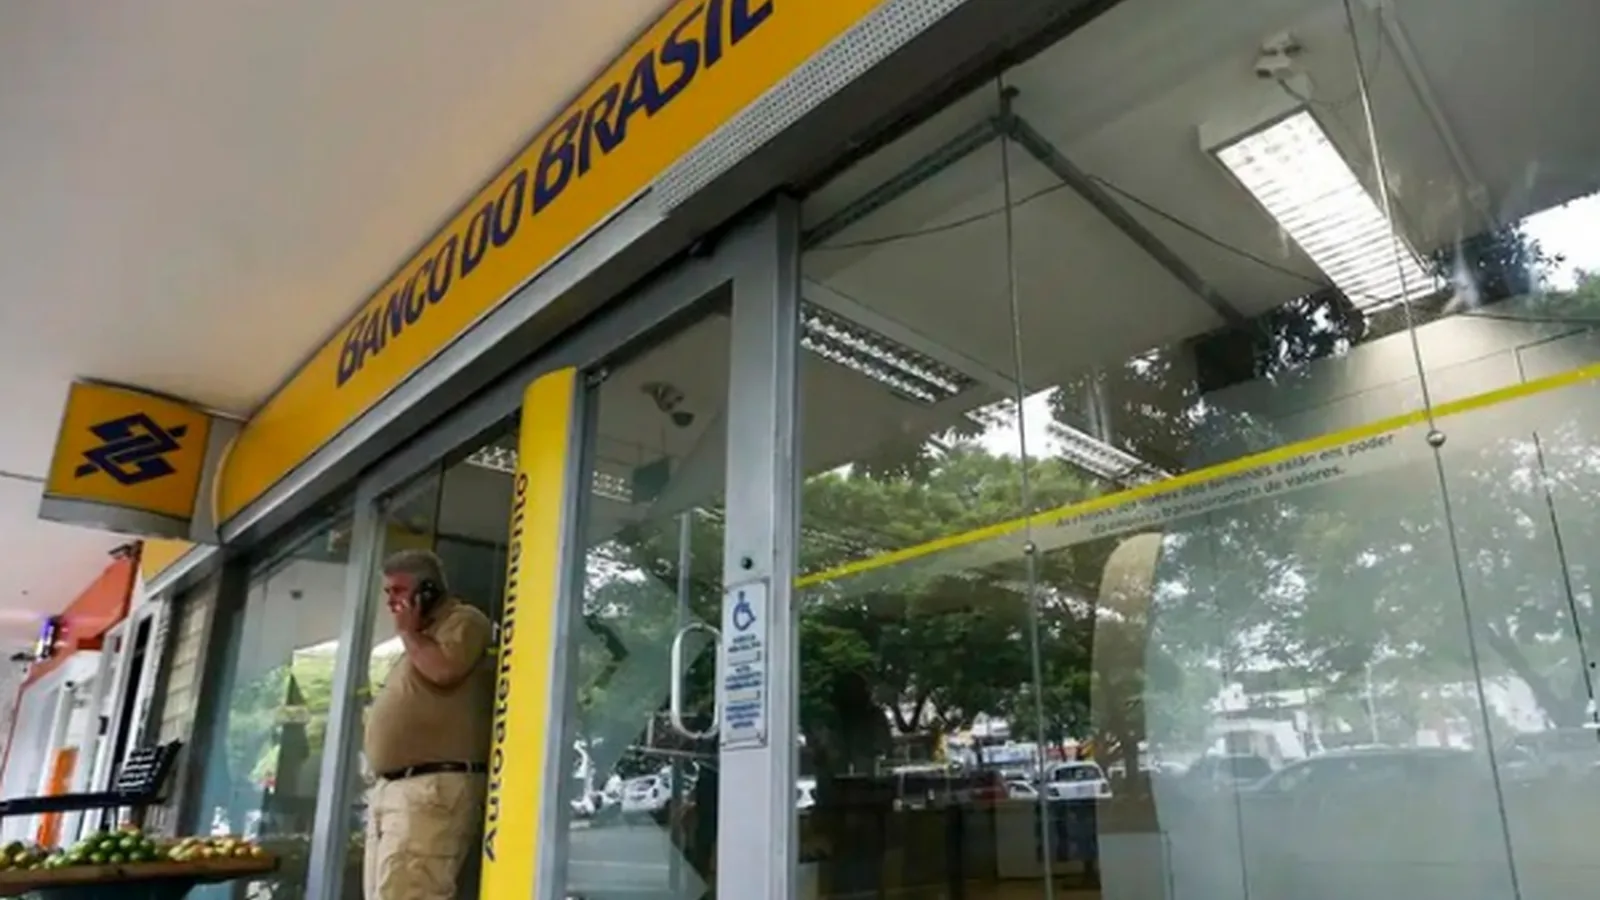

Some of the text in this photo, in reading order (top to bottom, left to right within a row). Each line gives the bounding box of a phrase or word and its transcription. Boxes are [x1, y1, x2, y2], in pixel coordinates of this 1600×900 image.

[337, 0, 774, 388] BANCO DO BRASIL
[1285, 465, 1346, 487] valores.
[1347, 434, 1394, 458] poder
[483, 472, 529, 862] Autoatendimento
